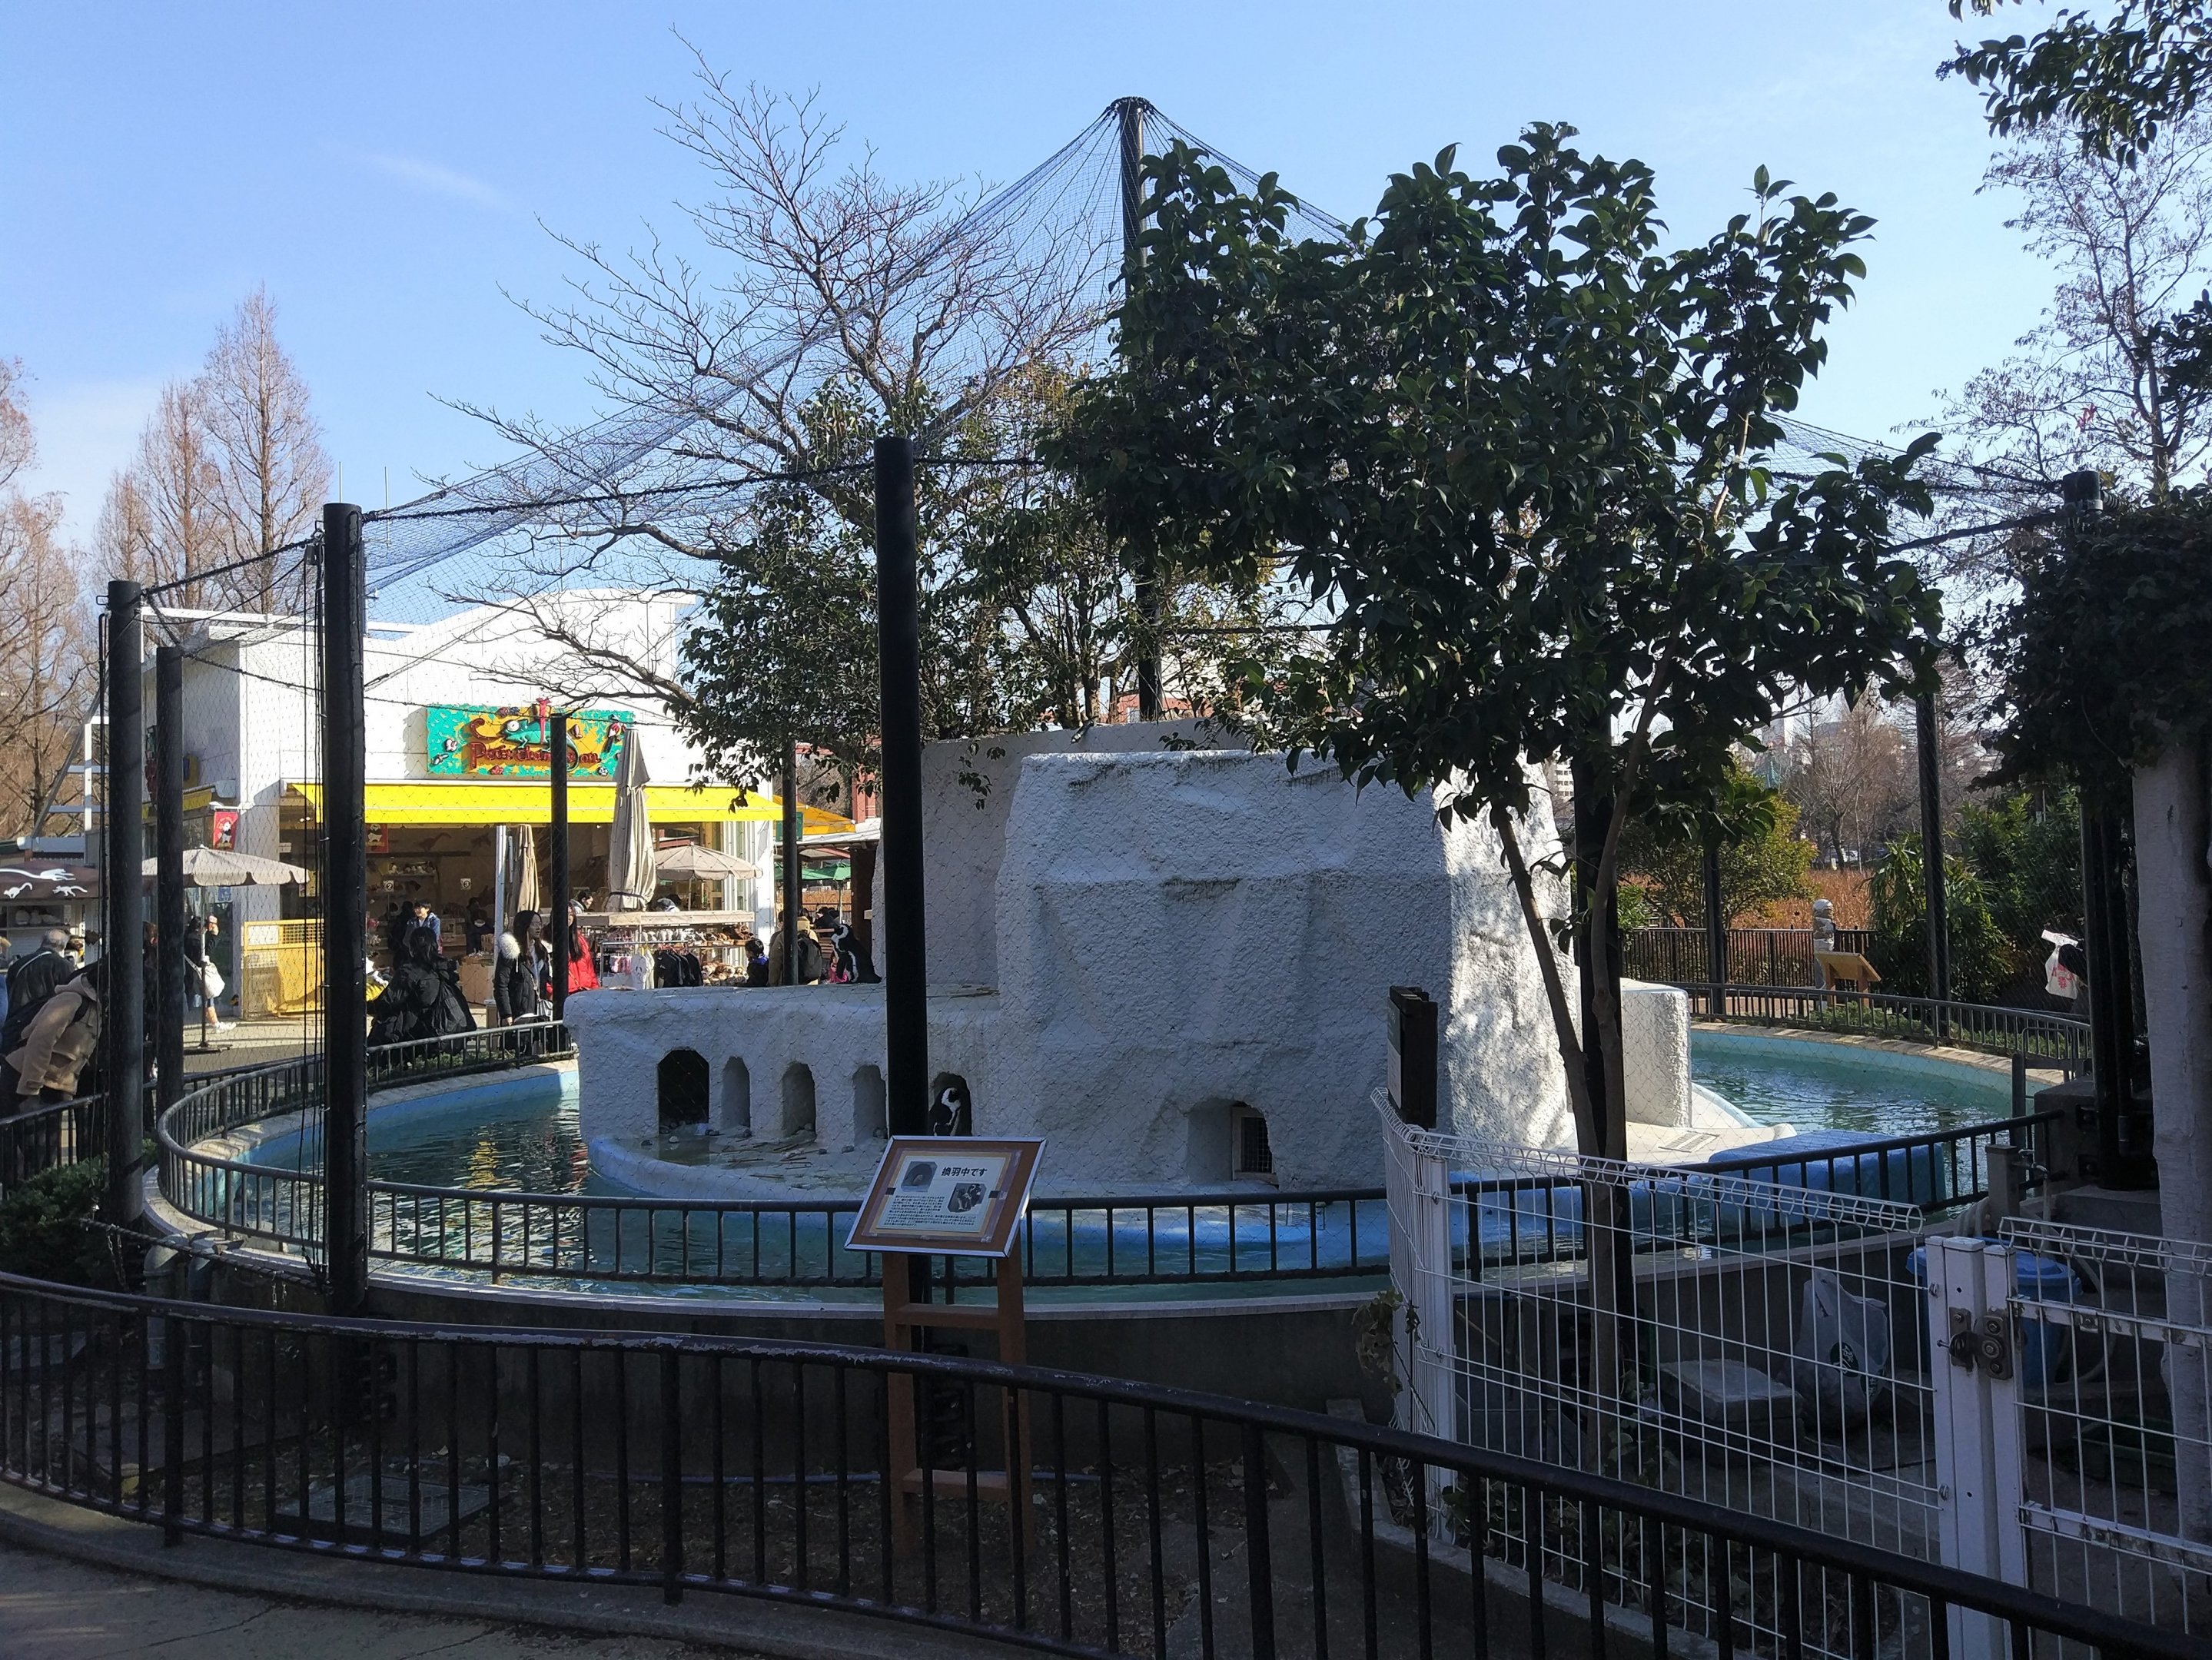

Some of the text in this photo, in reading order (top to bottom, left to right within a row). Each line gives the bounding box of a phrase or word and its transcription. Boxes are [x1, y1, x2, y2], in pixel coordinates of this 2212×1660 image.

[470, 741, 513, 769] Petit
[941, 1167, 988, 1177] 換羽中です
